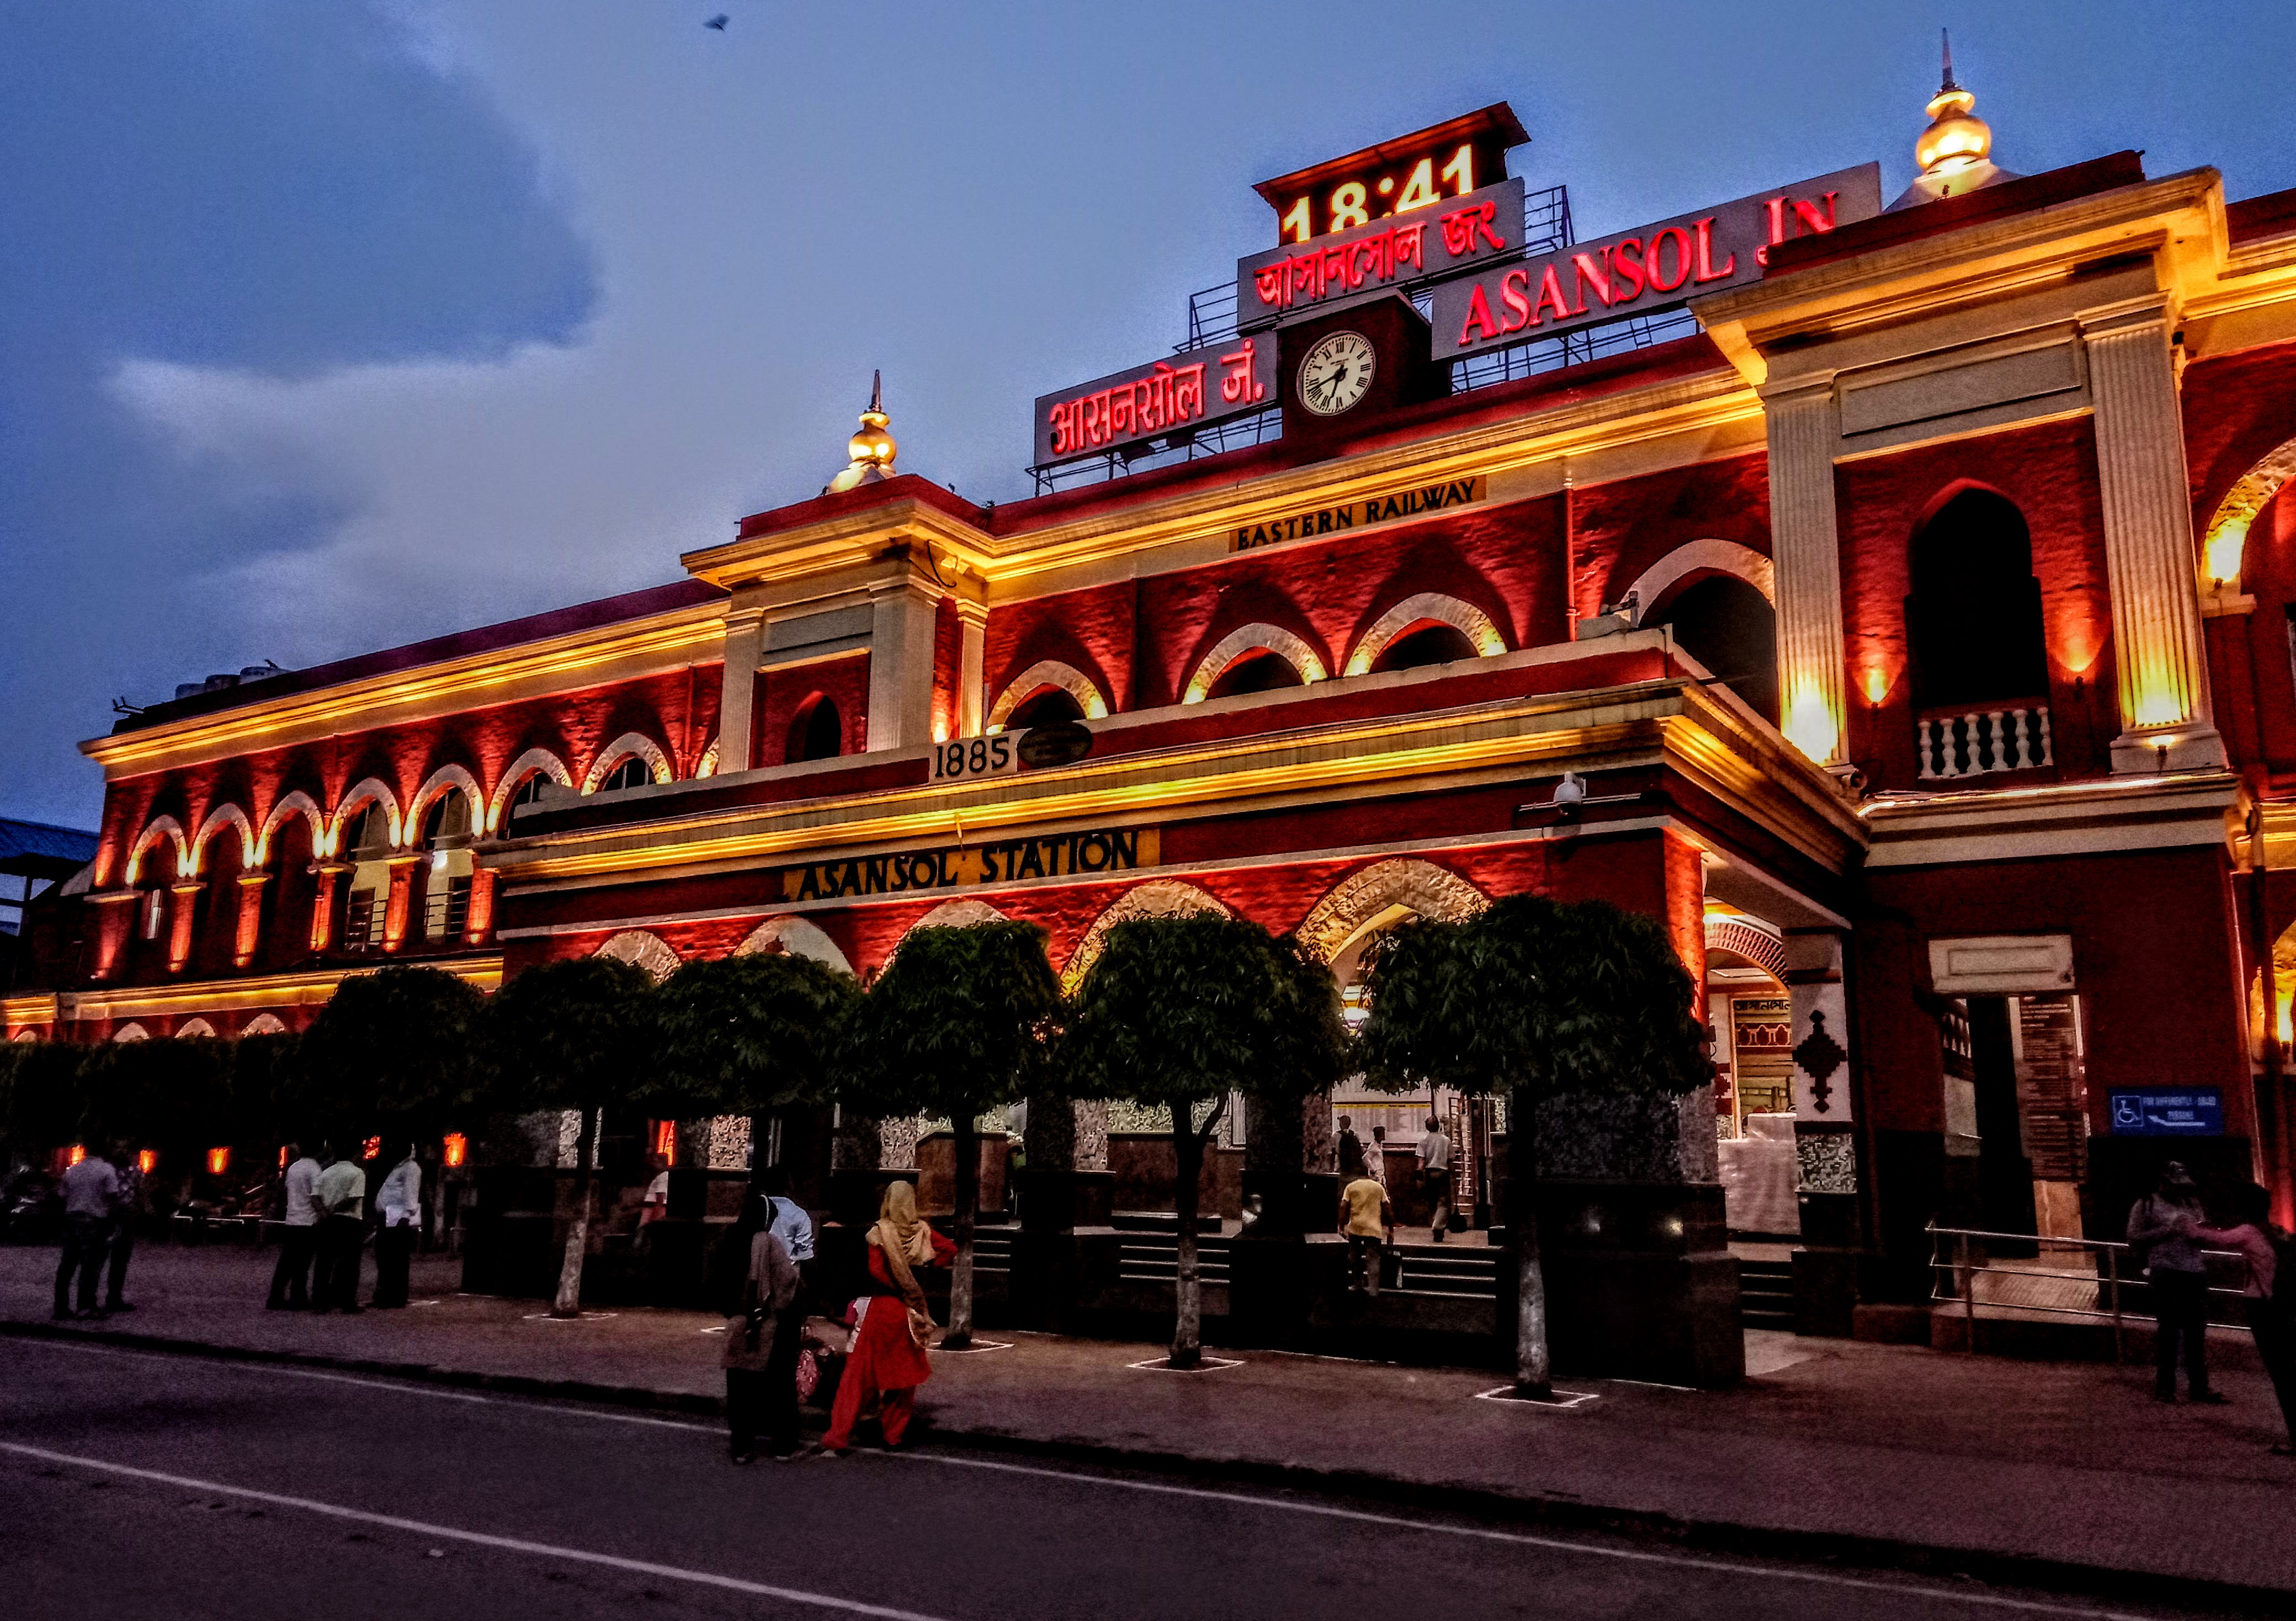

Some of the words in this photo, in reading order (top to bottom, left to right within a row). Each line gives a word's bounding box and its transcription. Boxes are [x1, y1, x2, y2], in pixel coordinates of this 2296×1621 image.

[1283, 144, 1474, 243] 18:41
[1253, 221, 1427, 309] আসানসোল
[1440, 200, 1506, 257] জং
[1458, 216, 1736, 347] ASANSOL
[1755, 191, 1839, 269] JN
[1049, 362, 1207, 455] आसनसोल
[1220, 338, 1266, 405] जं.
[1237, 506, 1353, 551] EASTERN
[1365, 478, 1476, 524] RAILWAY
[935, 736, 1009, 778] 1885
[798, 850, 958, 901] ASANSOL
[980, 830, 1138, 882] STATION
